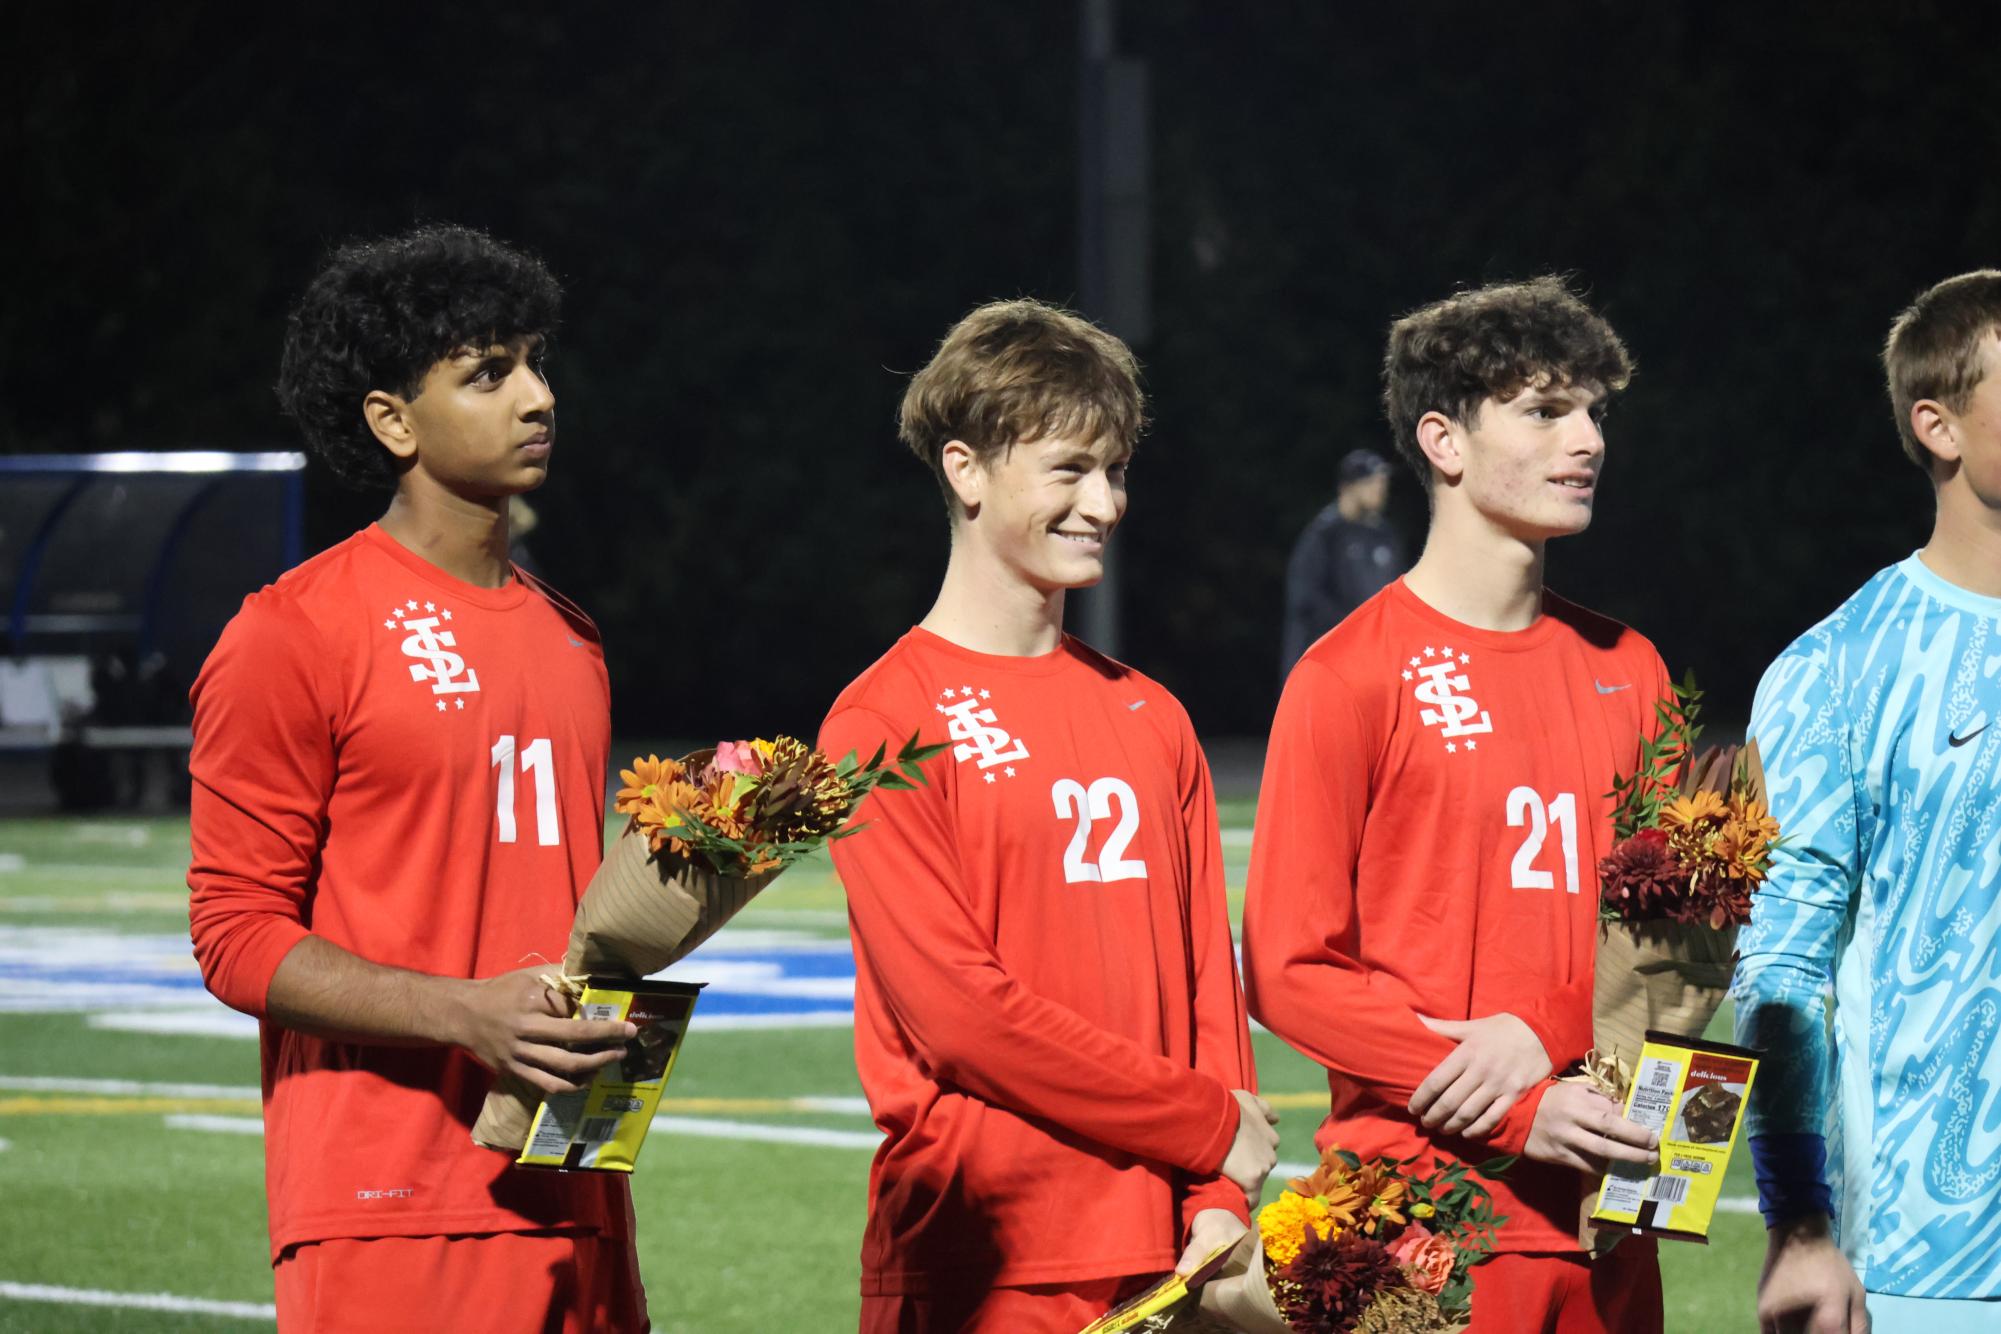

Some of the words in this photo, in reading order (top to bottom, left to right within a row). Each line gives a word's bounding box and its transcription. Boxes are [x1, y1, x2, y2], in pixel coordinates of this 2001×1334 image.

[491, 735, 560, 847] 11
[1051, 777, 1148, 884] 22
[1506, 786, 1580, 894] 21
[1690, 1070, 1727, 1081] delicious
[356, 1188, 415, 1200] DRI-FIT
